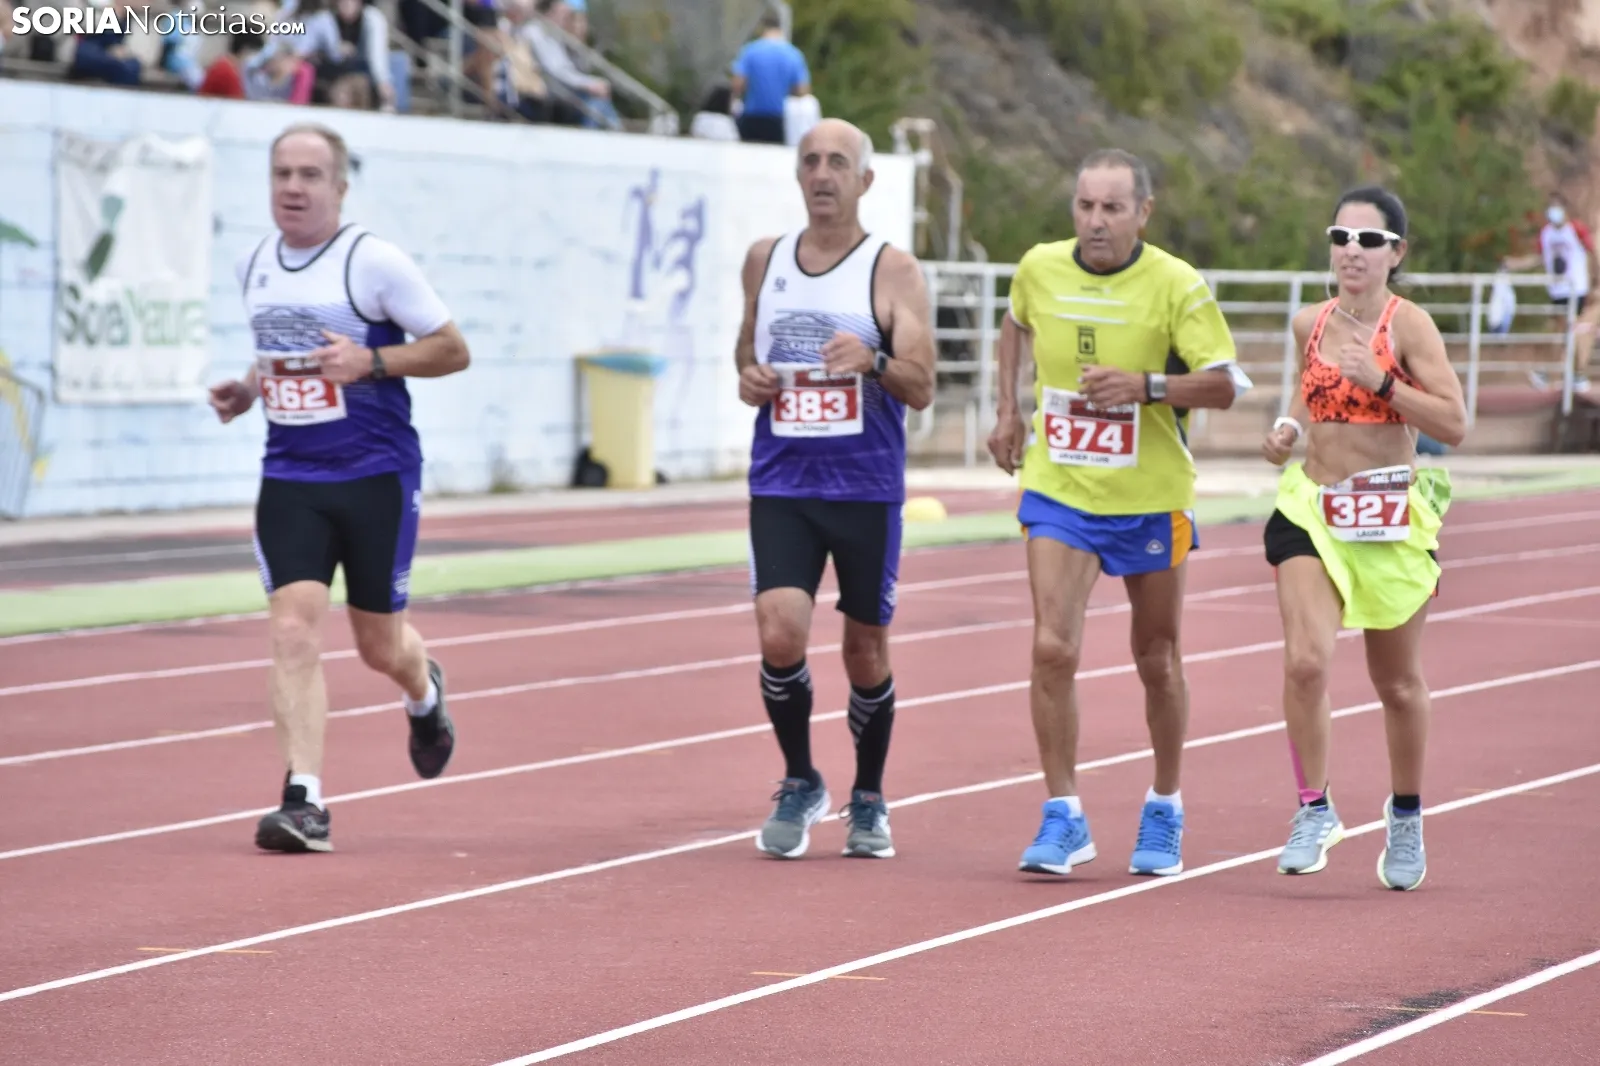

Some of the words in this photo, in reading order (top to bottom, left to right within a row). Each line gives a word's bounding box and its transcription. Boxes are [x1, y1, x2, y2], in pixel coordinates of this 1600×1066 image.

[262, 378, 328, 409] 362
[780, 390, 848, 421] 383
[1048, 416, 1124, 454] 374
[1330, 494, 1408, 526] 327
[1356, 530, 1386, 538] LAURA
